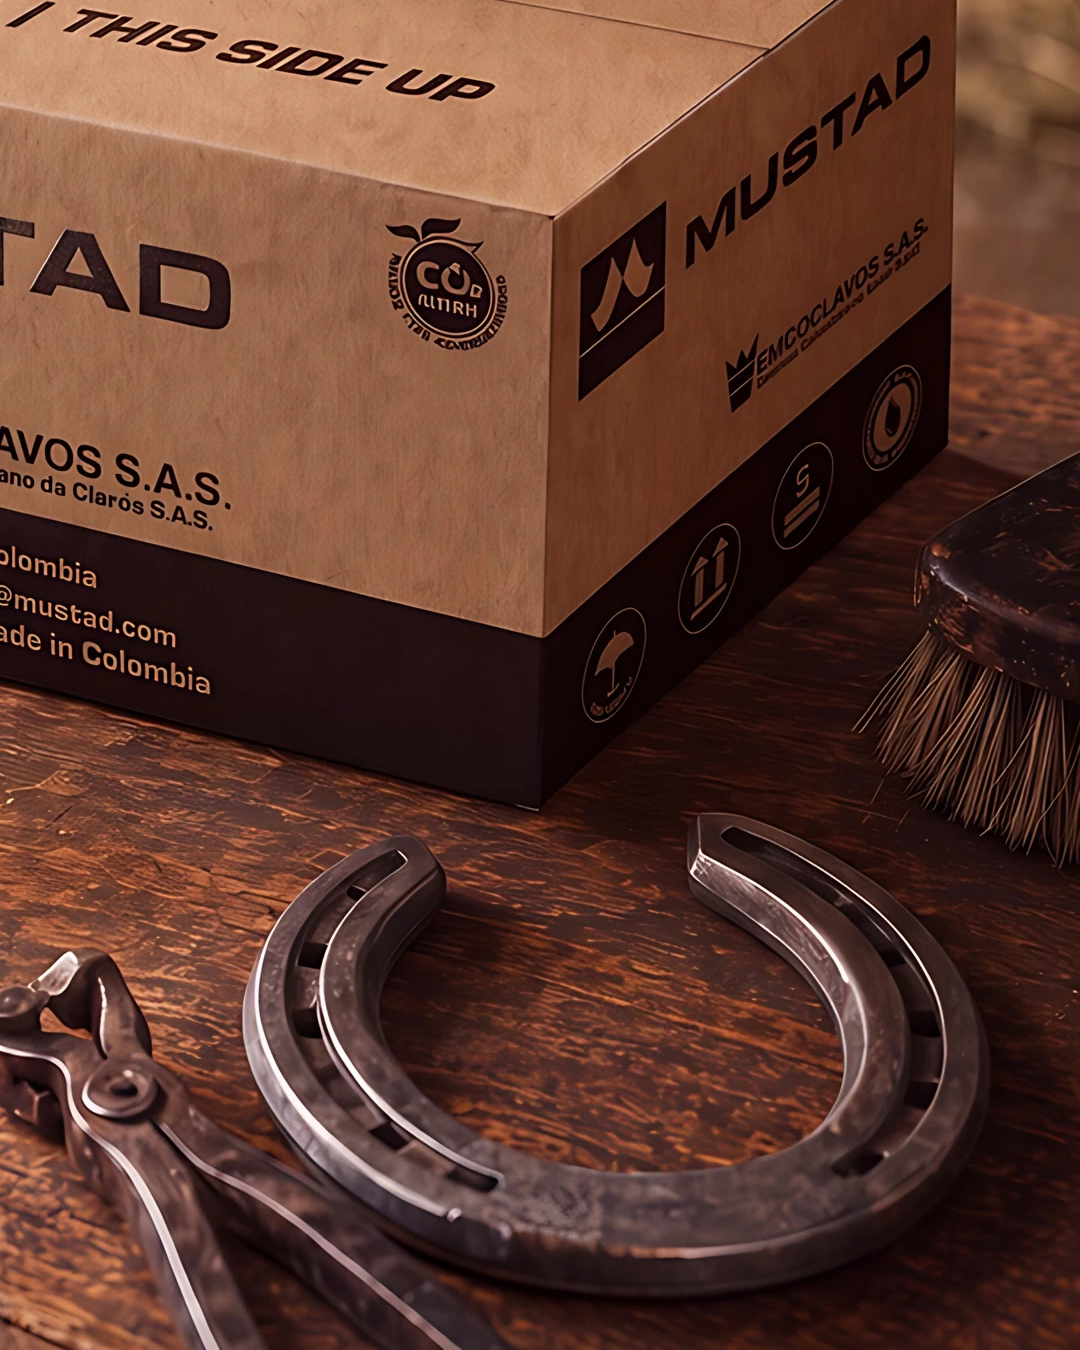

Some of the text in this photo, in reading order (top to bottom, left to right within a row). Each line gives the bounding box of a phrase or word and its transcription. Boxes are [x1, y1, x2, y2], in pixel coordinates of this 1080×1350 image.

[63, 8, 219, 54] THIS
[215, 39, 388, 86] SIDE
[384, 69, 497, 103] UP
[685, 34, 932, 270] MUSTAD
[757, 255, 880, 376] EMCOCLAVOS
[40, 475, 67, 497] da
[149, 500, 214, 531] S.A.S.
[114, 452, 233, 510] S.A.S.
[50, 632, 74, 661] in
[82, 641, 212, 695] Colombia
